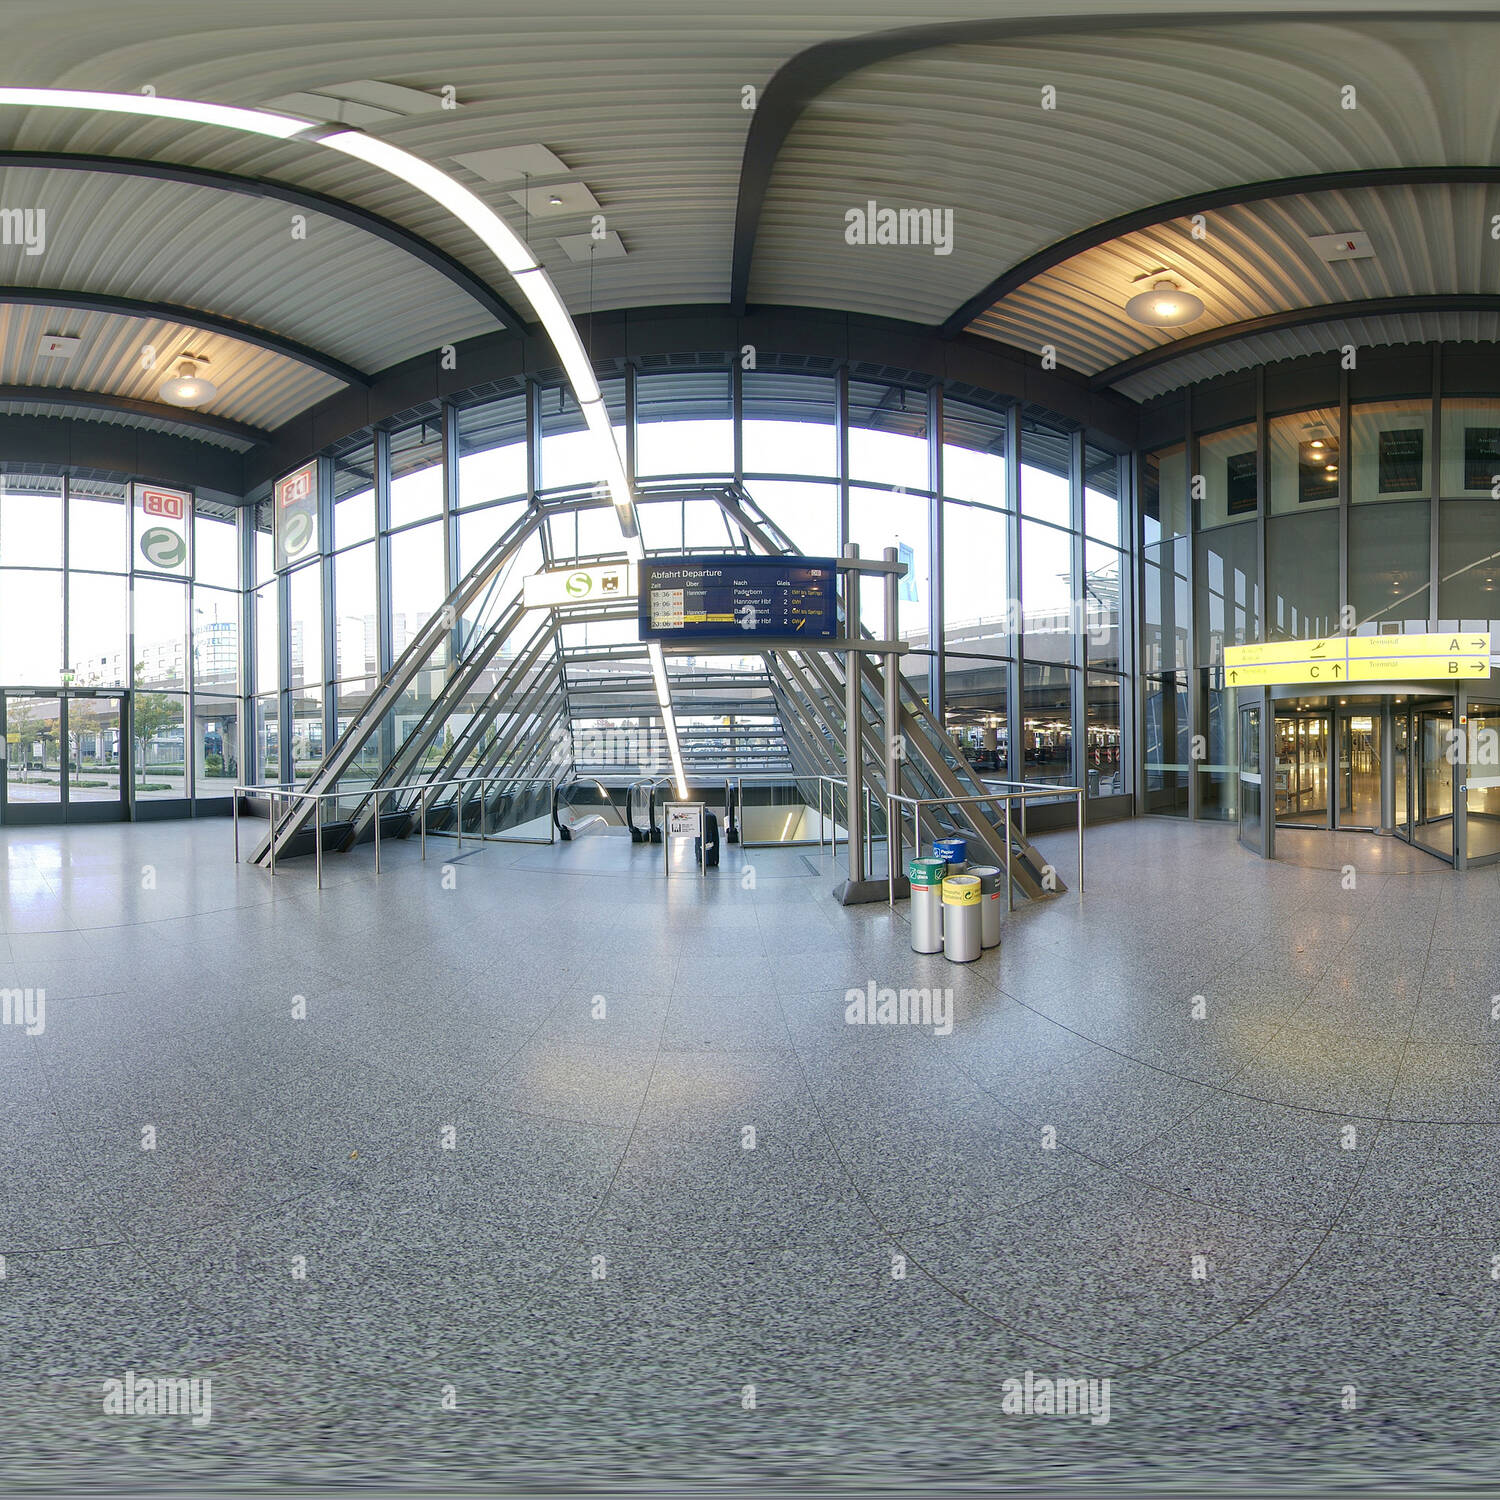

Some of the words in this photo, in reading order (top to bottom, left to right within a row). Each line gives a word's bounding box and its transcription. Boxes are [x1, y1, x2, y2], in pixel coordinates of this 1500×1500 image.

[651, 571, 680, 579] Abfahrt
[682, 570, 722, 578] Departure
[1450, 639, 1460, 651] A
[1310, 666, 1320, 678] C
[1448, 662, 1458, 674] B
